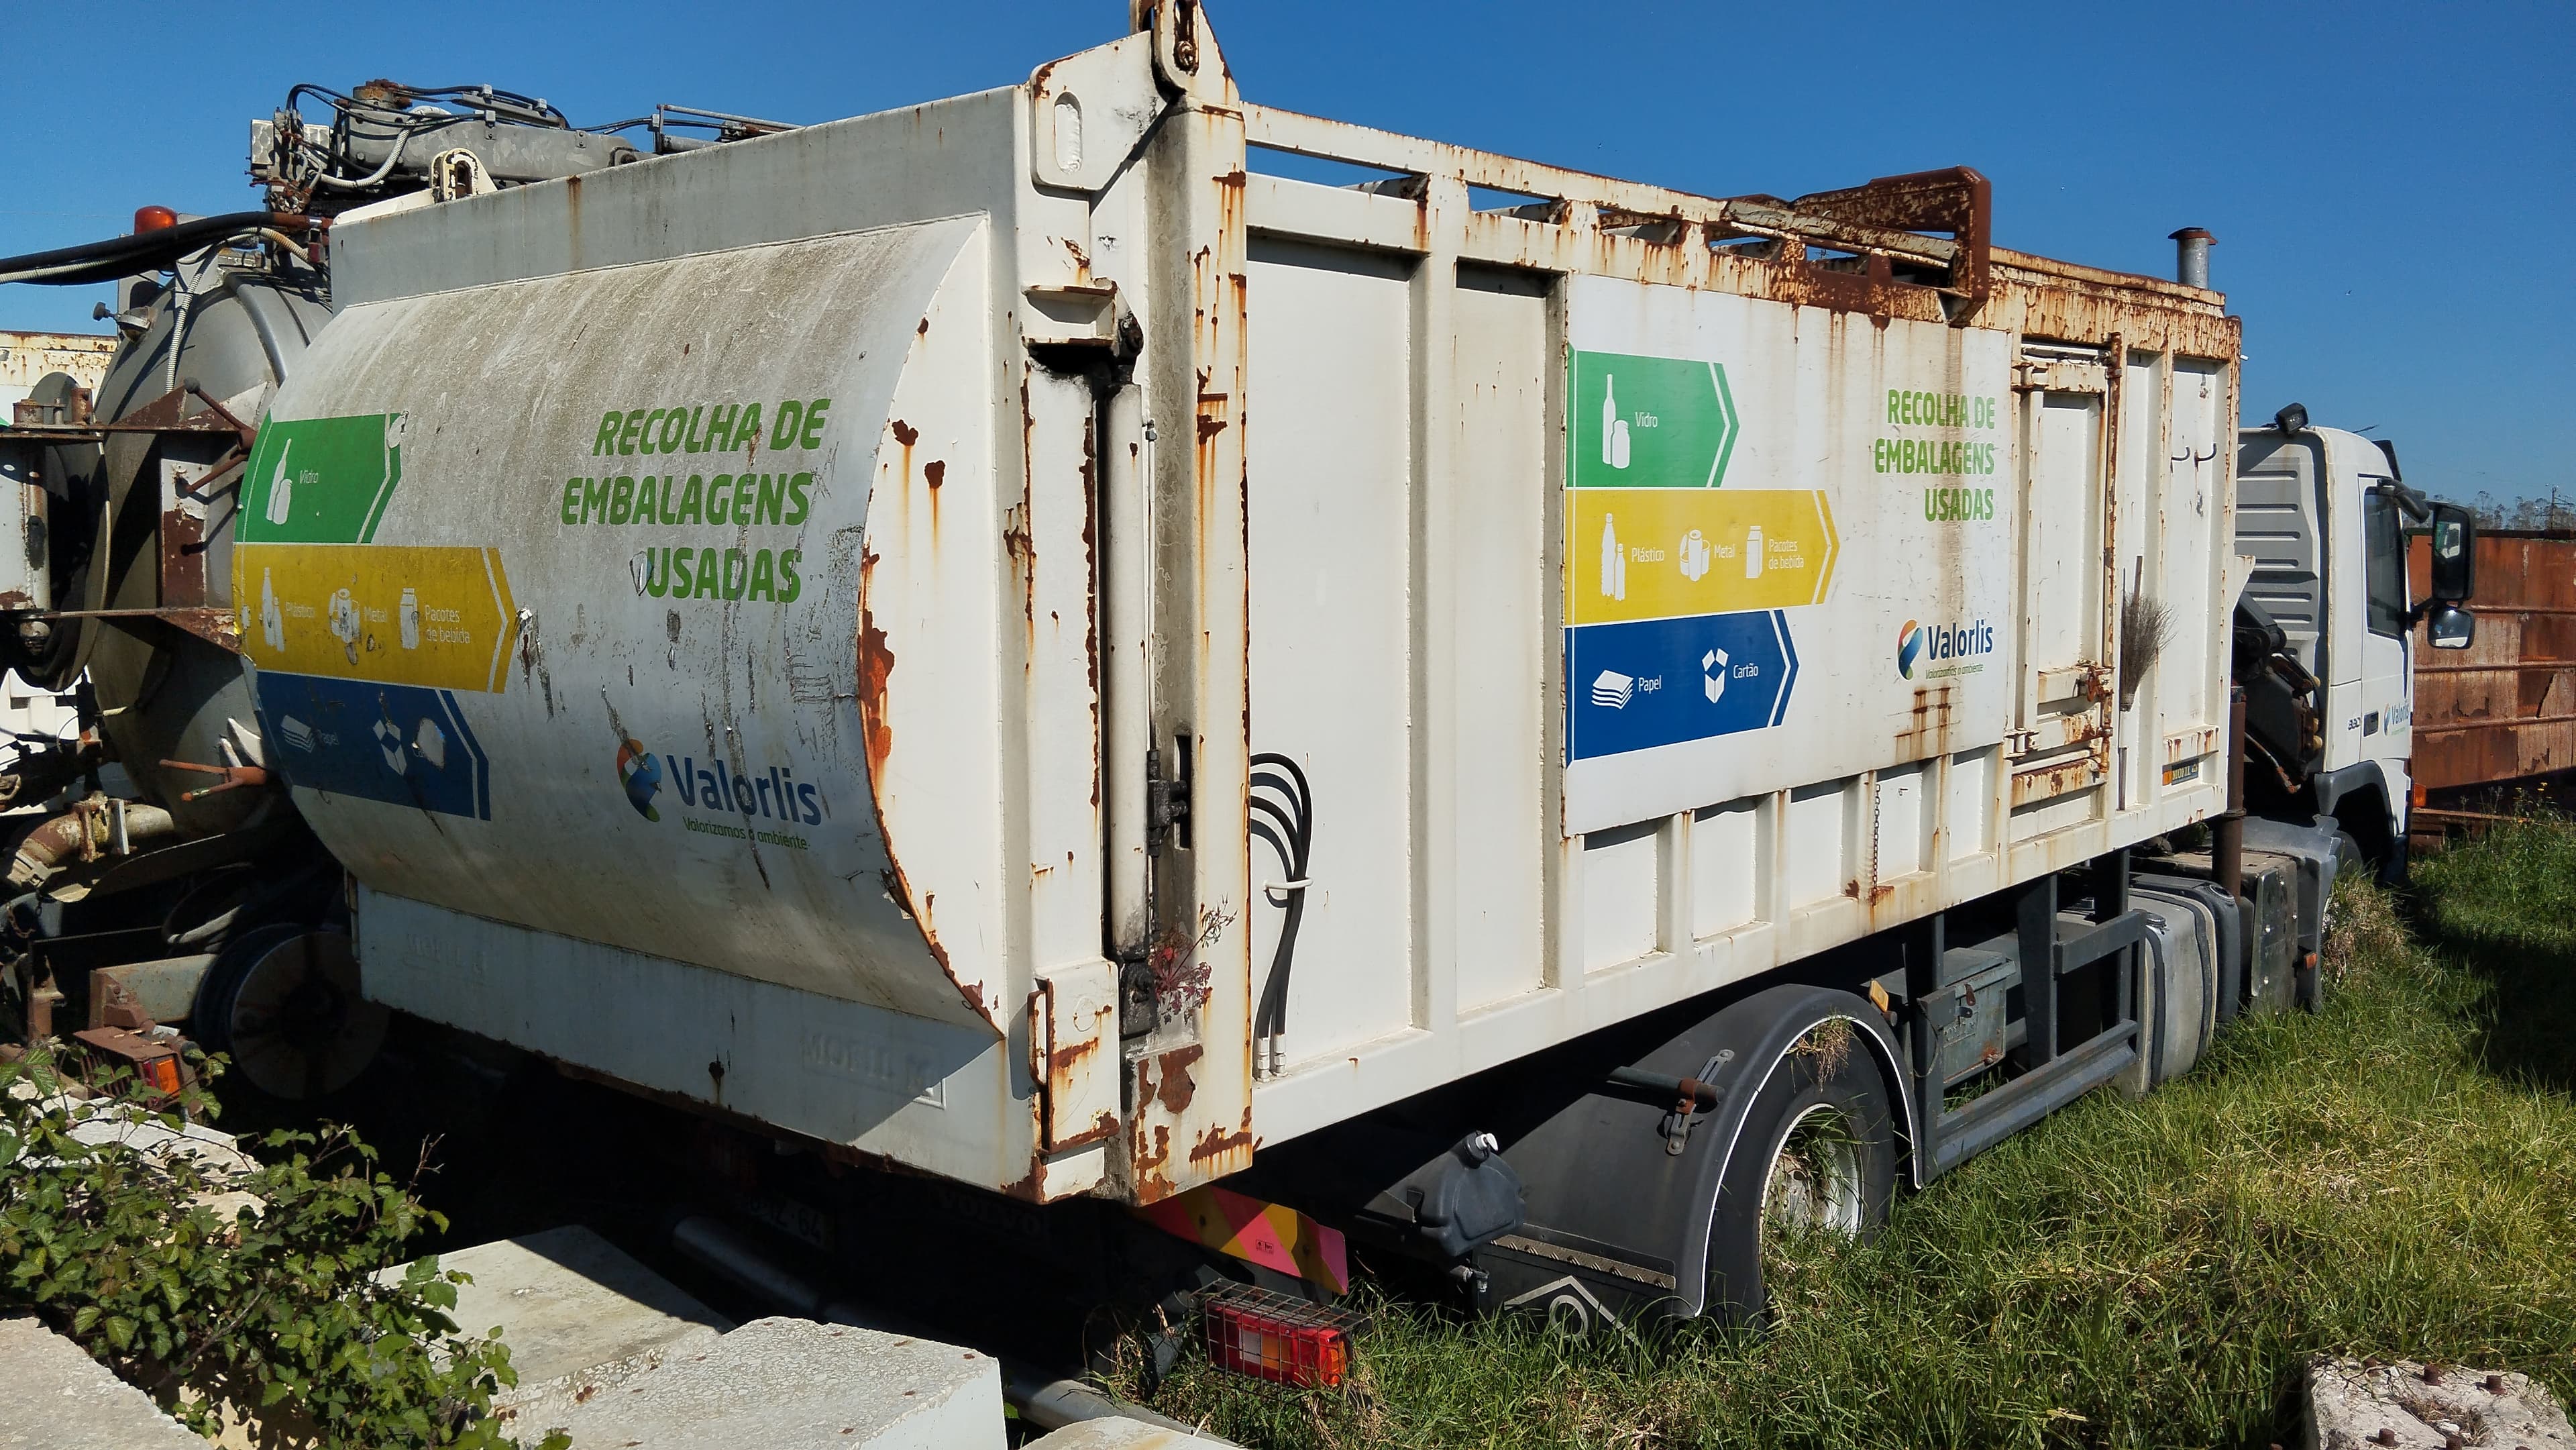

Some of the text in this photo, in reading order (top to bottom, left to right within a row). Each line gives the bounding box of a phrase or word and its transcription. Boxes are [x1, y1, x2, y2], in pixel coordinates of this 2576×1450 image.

[1635, 411, 1658, 428] Vidro
[1886, 389, 1996, 429] RECOLHA DE
[592, 398, 832, 457] RECOLHA DE
[1875, 437, 1995, 475] EMBALAGENS
[561, 472, 812, 526] EMBALAGENS
[1924, 488, 1994, 522] USADAS
[1631, 546, 1665, 562] Plástico
[1714, 543, 1735, 558] Metal
[1768, 538, 1799, 553] Pacotes
[1768, 554, 1805, 570] de bebida
[646, 547, 802, 604] USADAS
[425, 604, 461, 623] Pacotes
[1927, 619, 1993, 662] Valorlis
[1733, 662, 1759, 679] Cartão
[1638, 674, 1662, 694] Papel
[666, 754, 822, 826] Valorlis
[682, 816, 746, 839] Valorizamos
